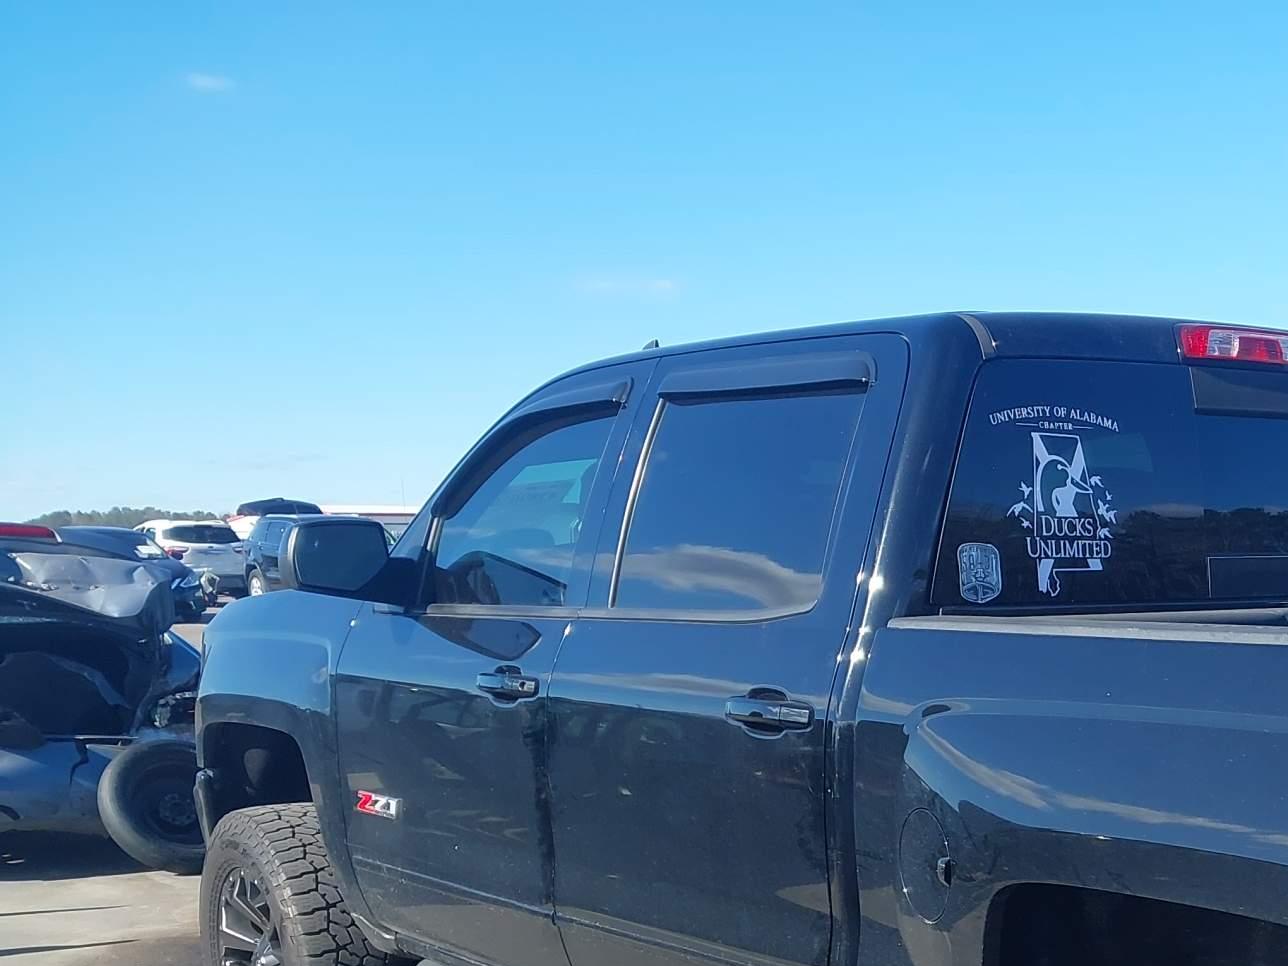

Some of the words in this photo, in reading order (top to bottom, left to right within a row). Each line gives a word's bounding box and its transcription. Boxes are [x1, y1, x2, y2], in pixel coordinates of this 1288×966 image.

[989, 405, 1051, 425] UNIVERSITY
[1053, 406, 1067, 418] OF
[1069, 408, 1120, 432] ALABAMA
[1038, 421, 1073, 430] CHAPTER
[1040, 515, 1094, 537] DUCKS
[1025, 536, 1112, 558] UNLIMITED
[357, 790, 398, 816] Z71
